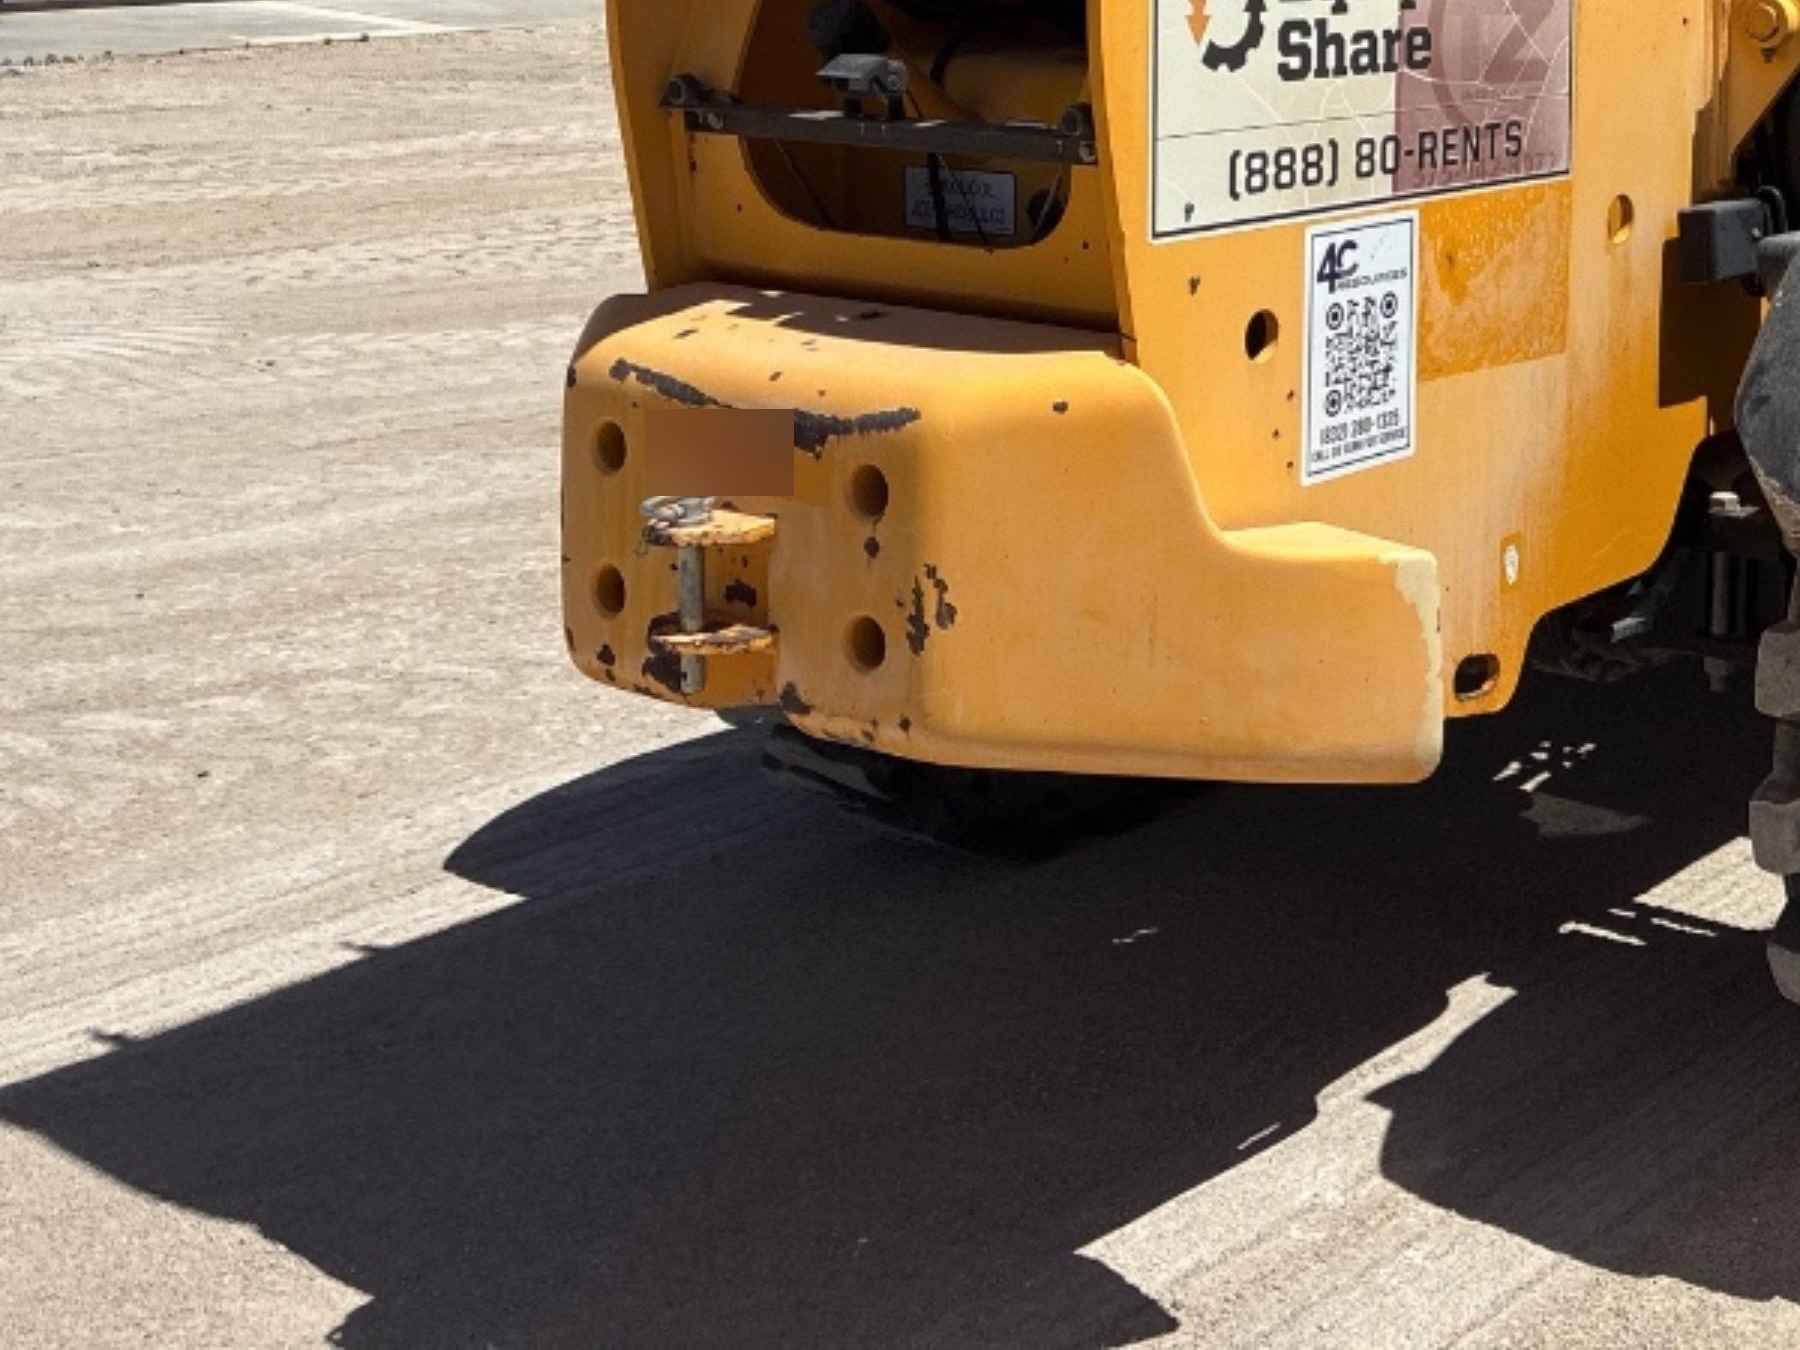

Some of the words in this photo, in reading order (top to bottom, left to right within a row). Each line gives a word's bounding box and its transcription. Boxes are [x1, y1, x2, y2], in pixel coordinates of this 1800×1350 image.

[1278, 18, 1433, 83] Share
[1227, 144, 1341, 200] (888)
[1355, 119, 1525, 181] 80-RENTS
